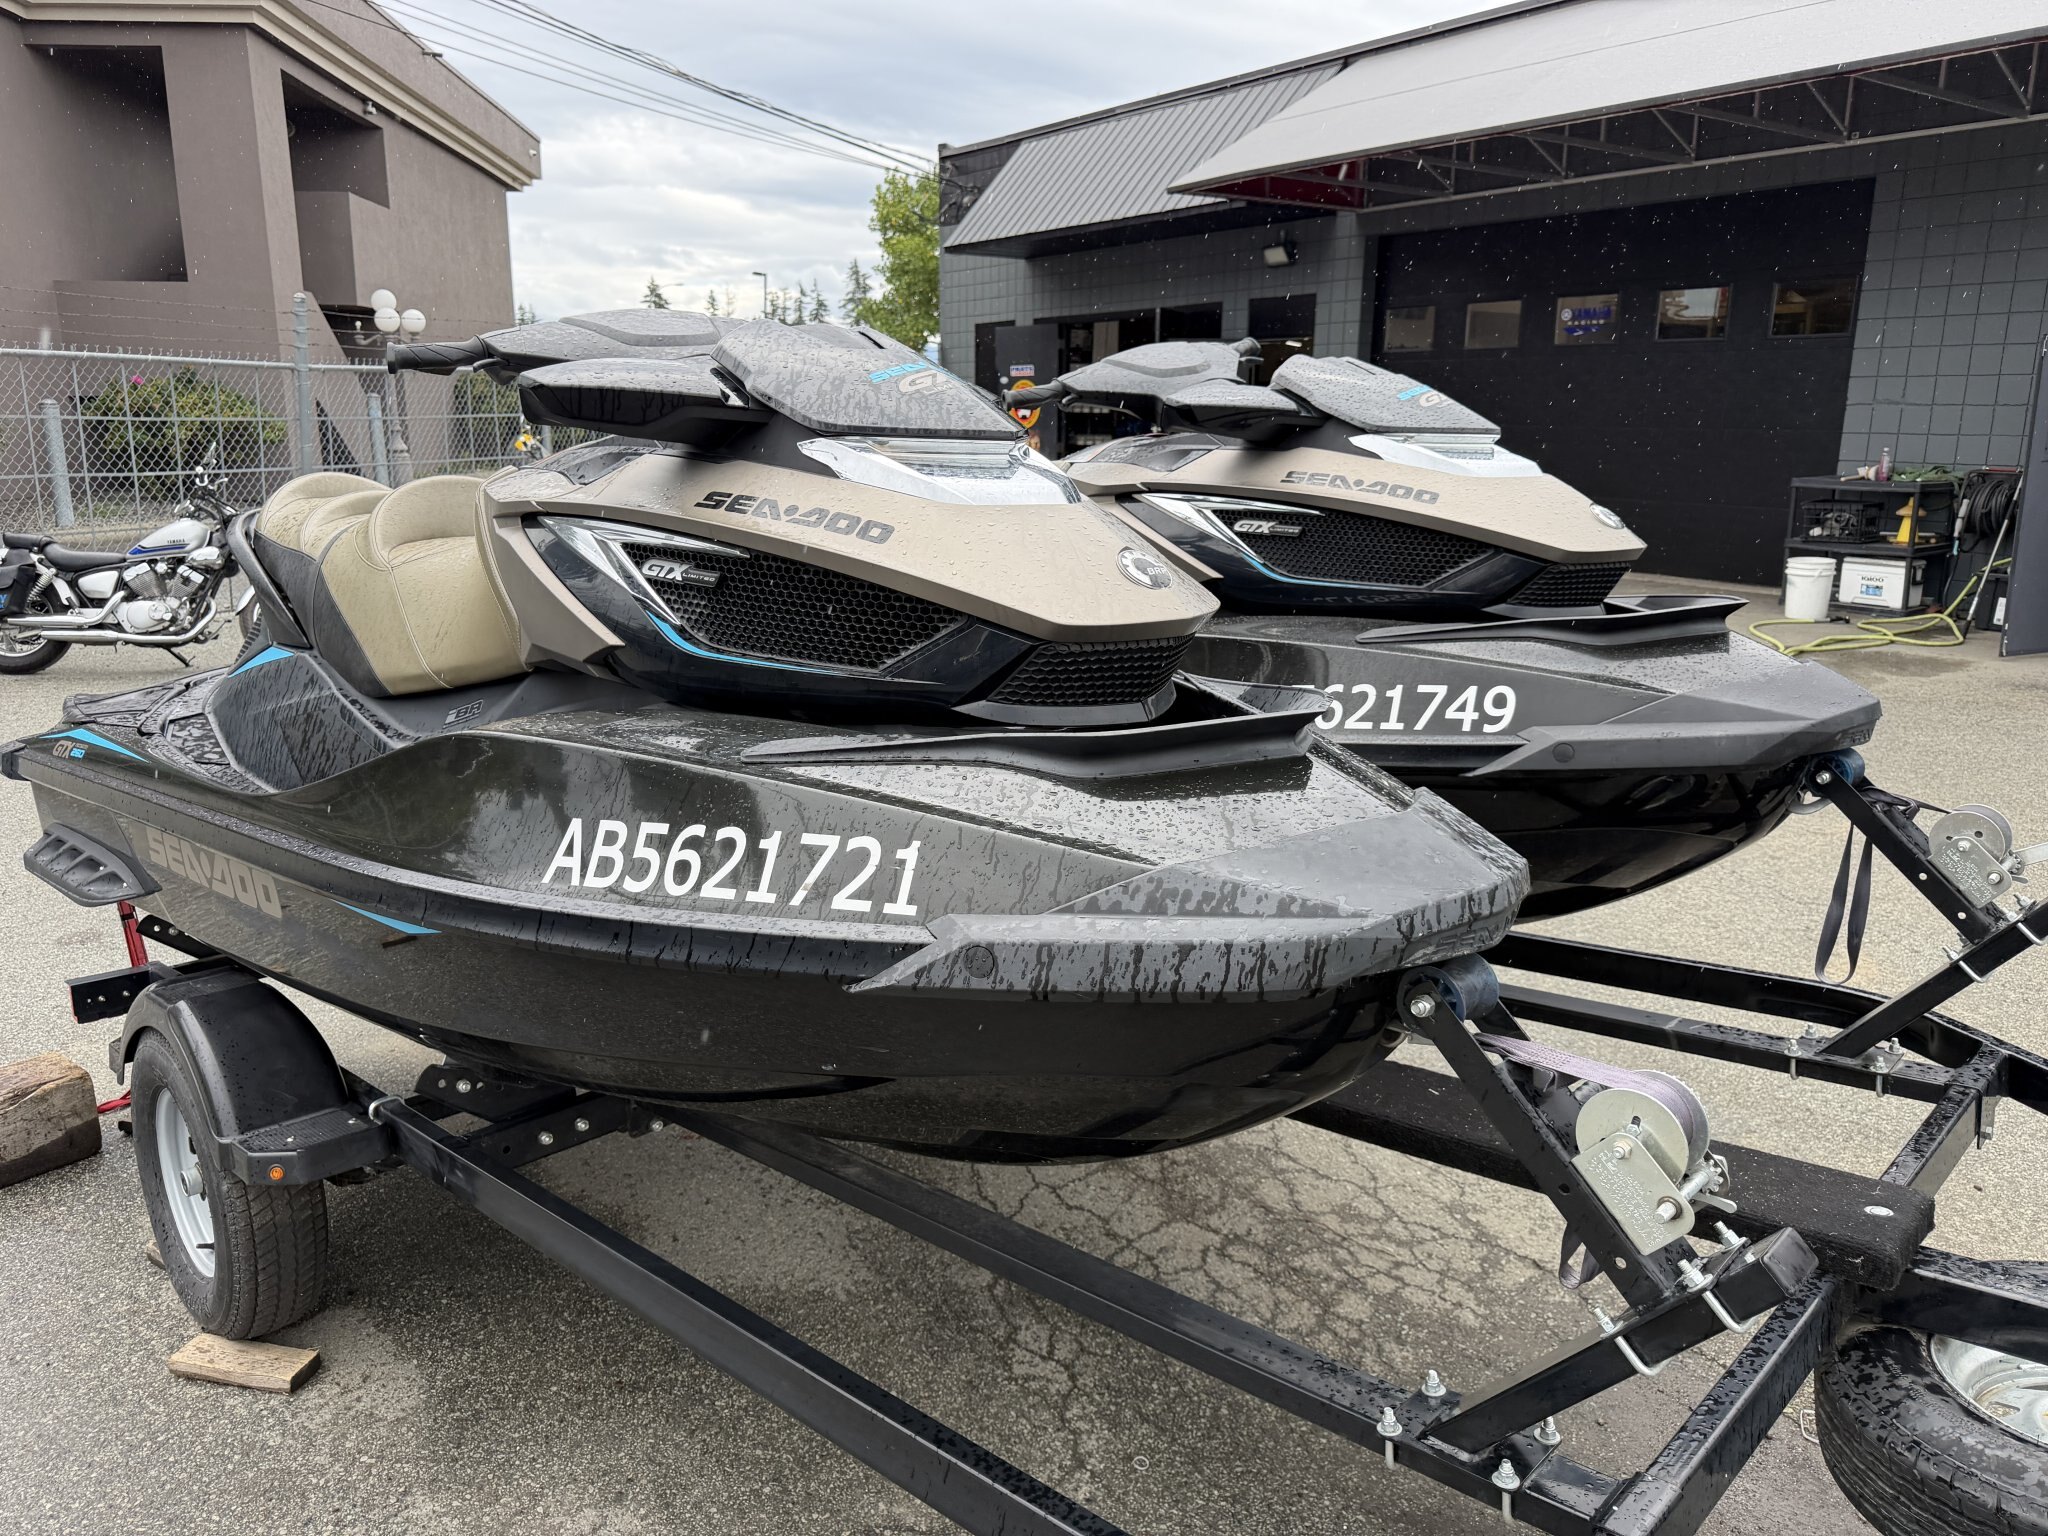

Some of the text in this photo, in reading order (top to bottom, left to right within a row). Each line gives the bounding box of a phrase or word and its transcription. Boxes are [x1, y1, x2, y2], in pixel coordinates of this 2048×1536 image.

[1233, 520, 1276, 534] GTX
[641, 559, 716, 582] GTX LIMITED
[52, 739, 75, 759] GTX
[541, 817, 922, 917] AB5621721
